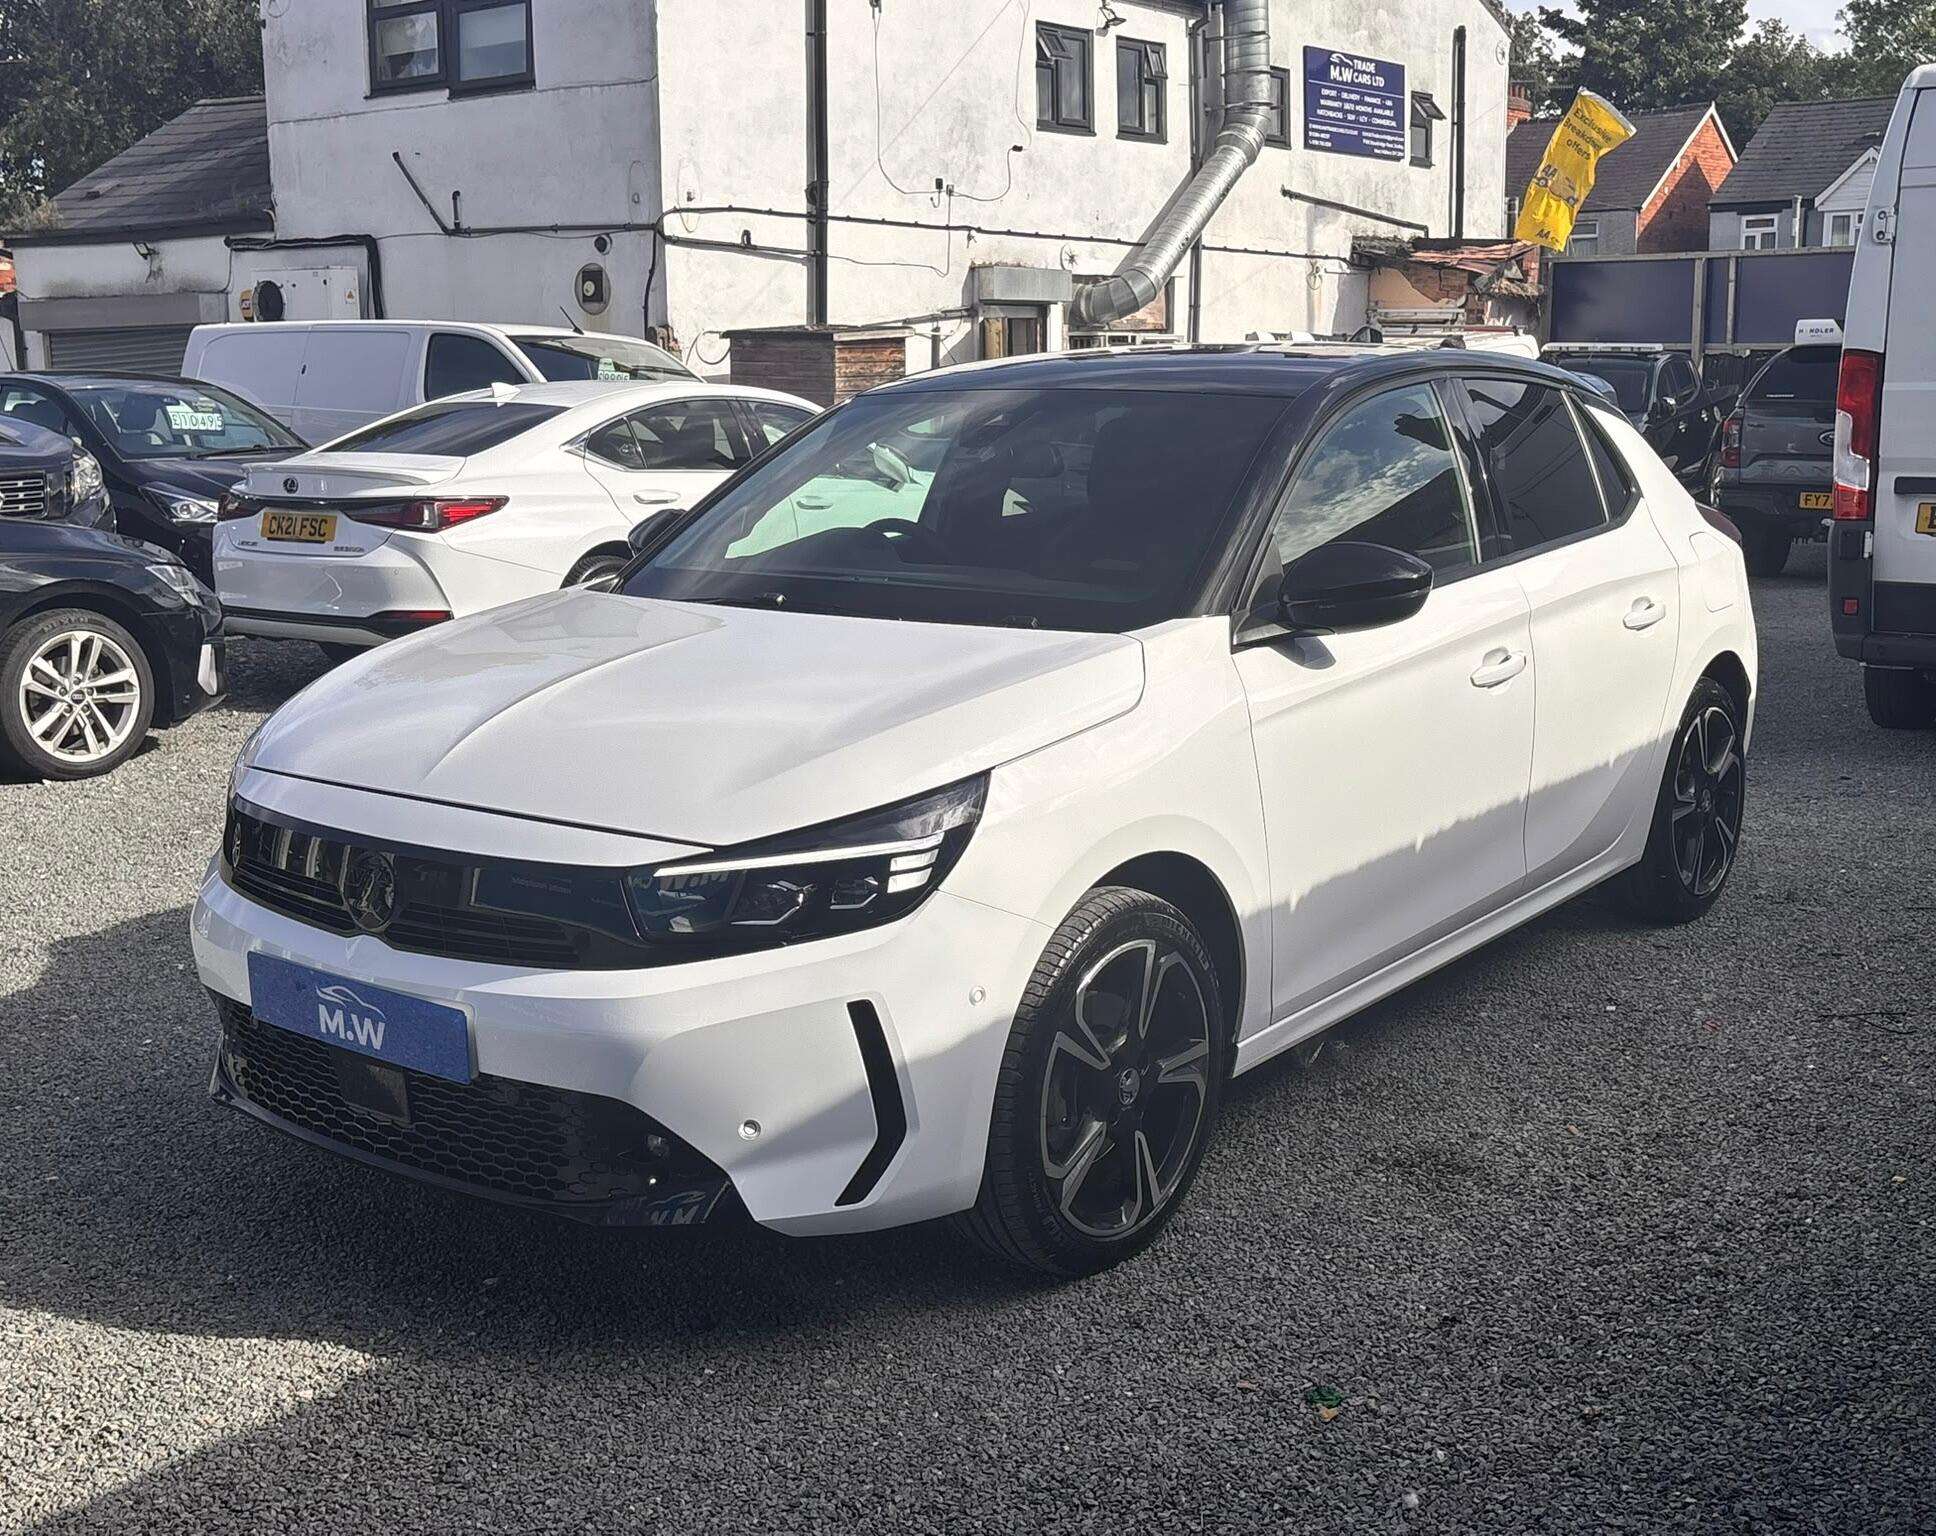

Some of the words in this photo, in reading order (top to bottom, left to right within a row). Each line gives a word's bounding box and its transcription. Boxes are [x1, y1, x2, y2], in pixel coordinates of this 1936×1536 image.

[1330, 64, 1353, 83] M.W
[1353, 72, 1371, 85] CARS
[1372, 75, 1385, 87] LTD
[1353, 59, 1376, 73] TRADE
[1566, 138, 1591, 161] offers
[172, 413, 224, 428] £10495
[1804, 494, 1833, 506] FY7
[268, 516, 298, 535] CK21
[299, 517, 328, 537] FSC
[317, 1003, 386, 1050] M.W
